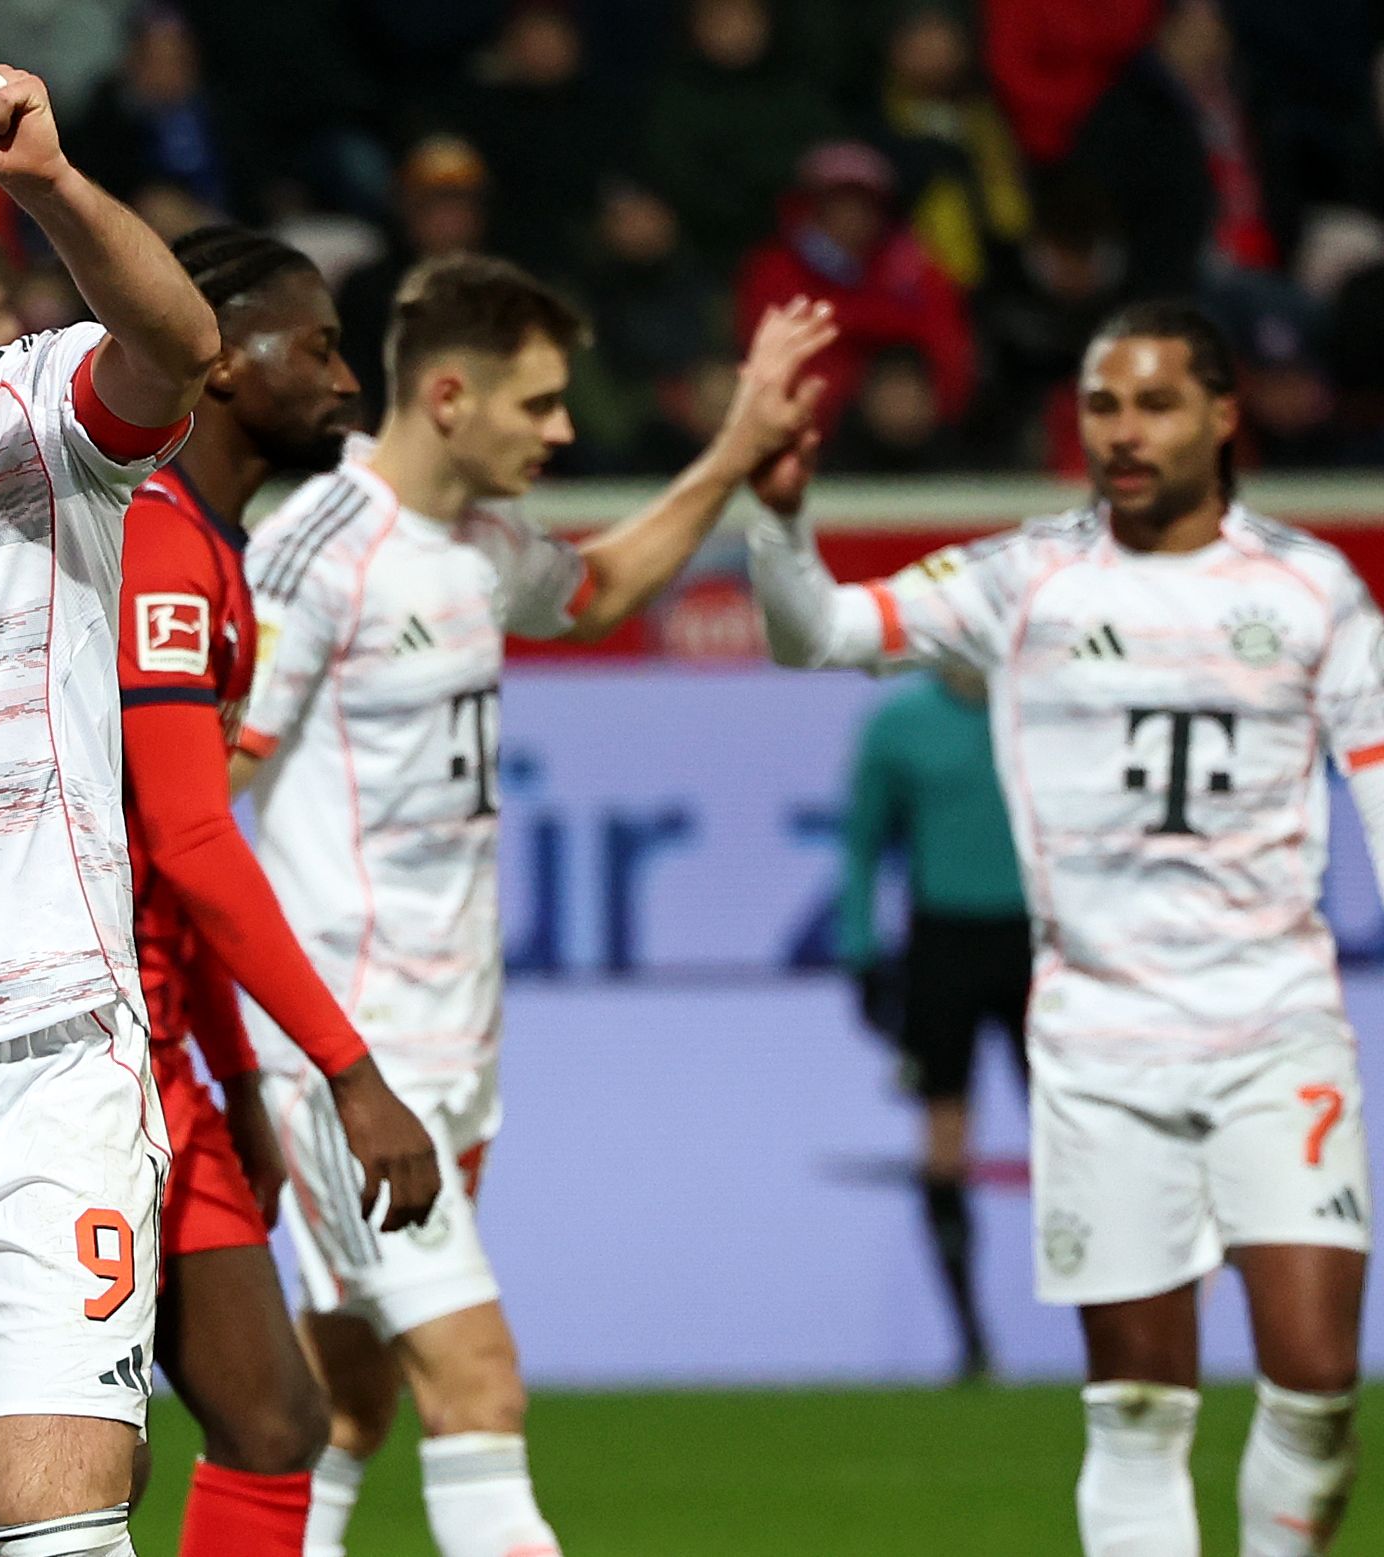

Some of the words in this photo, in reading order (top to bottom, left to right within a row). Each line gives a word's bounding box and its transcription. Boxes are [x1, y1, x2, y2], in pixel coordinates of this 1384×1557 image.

[1125, 708, 1237, 835] T
[1296, 1083, 1345, 1167] 7
[75, 1207, 135, 1321] 9
